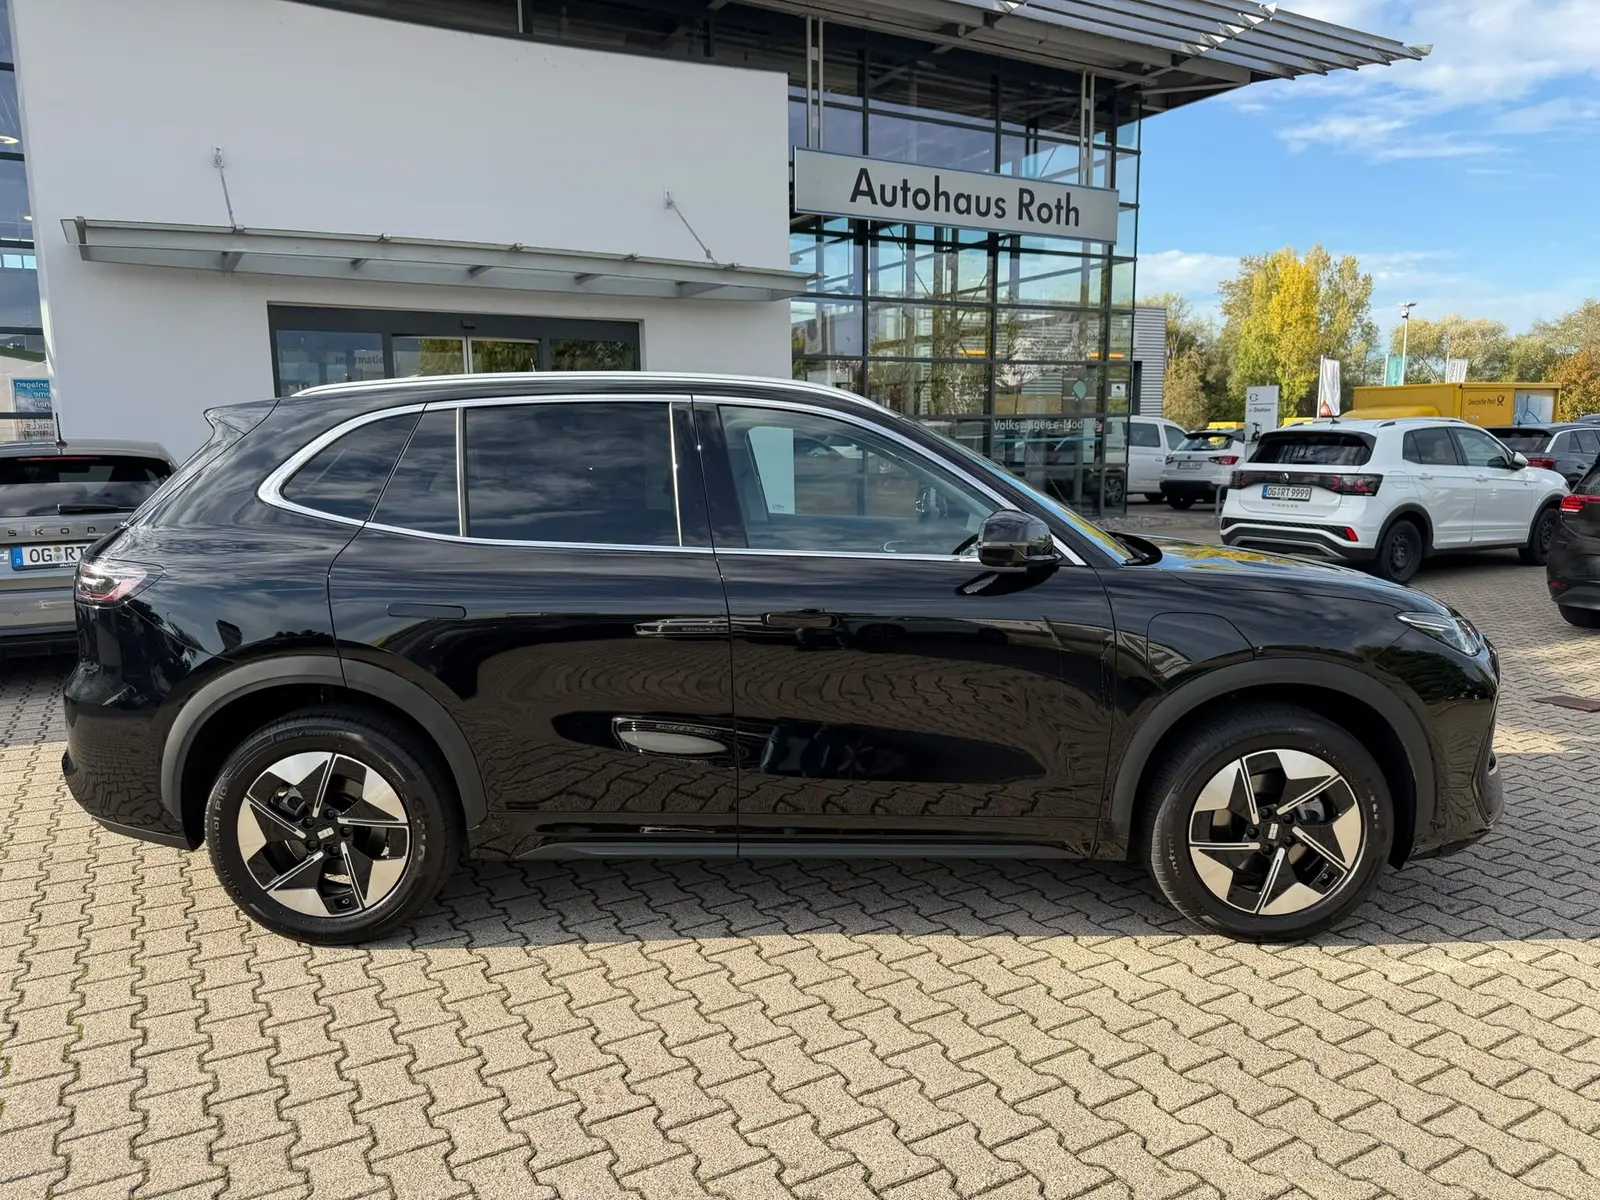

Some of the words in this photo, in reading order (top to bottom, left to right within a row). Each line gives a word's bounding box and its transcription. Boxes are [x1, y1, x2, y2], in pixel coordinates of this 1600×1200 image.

[850, 167, 1006, 219] Autohaus
[1018, 187, 1080, 227] Roth
[29, 547, 53, 563] OG
